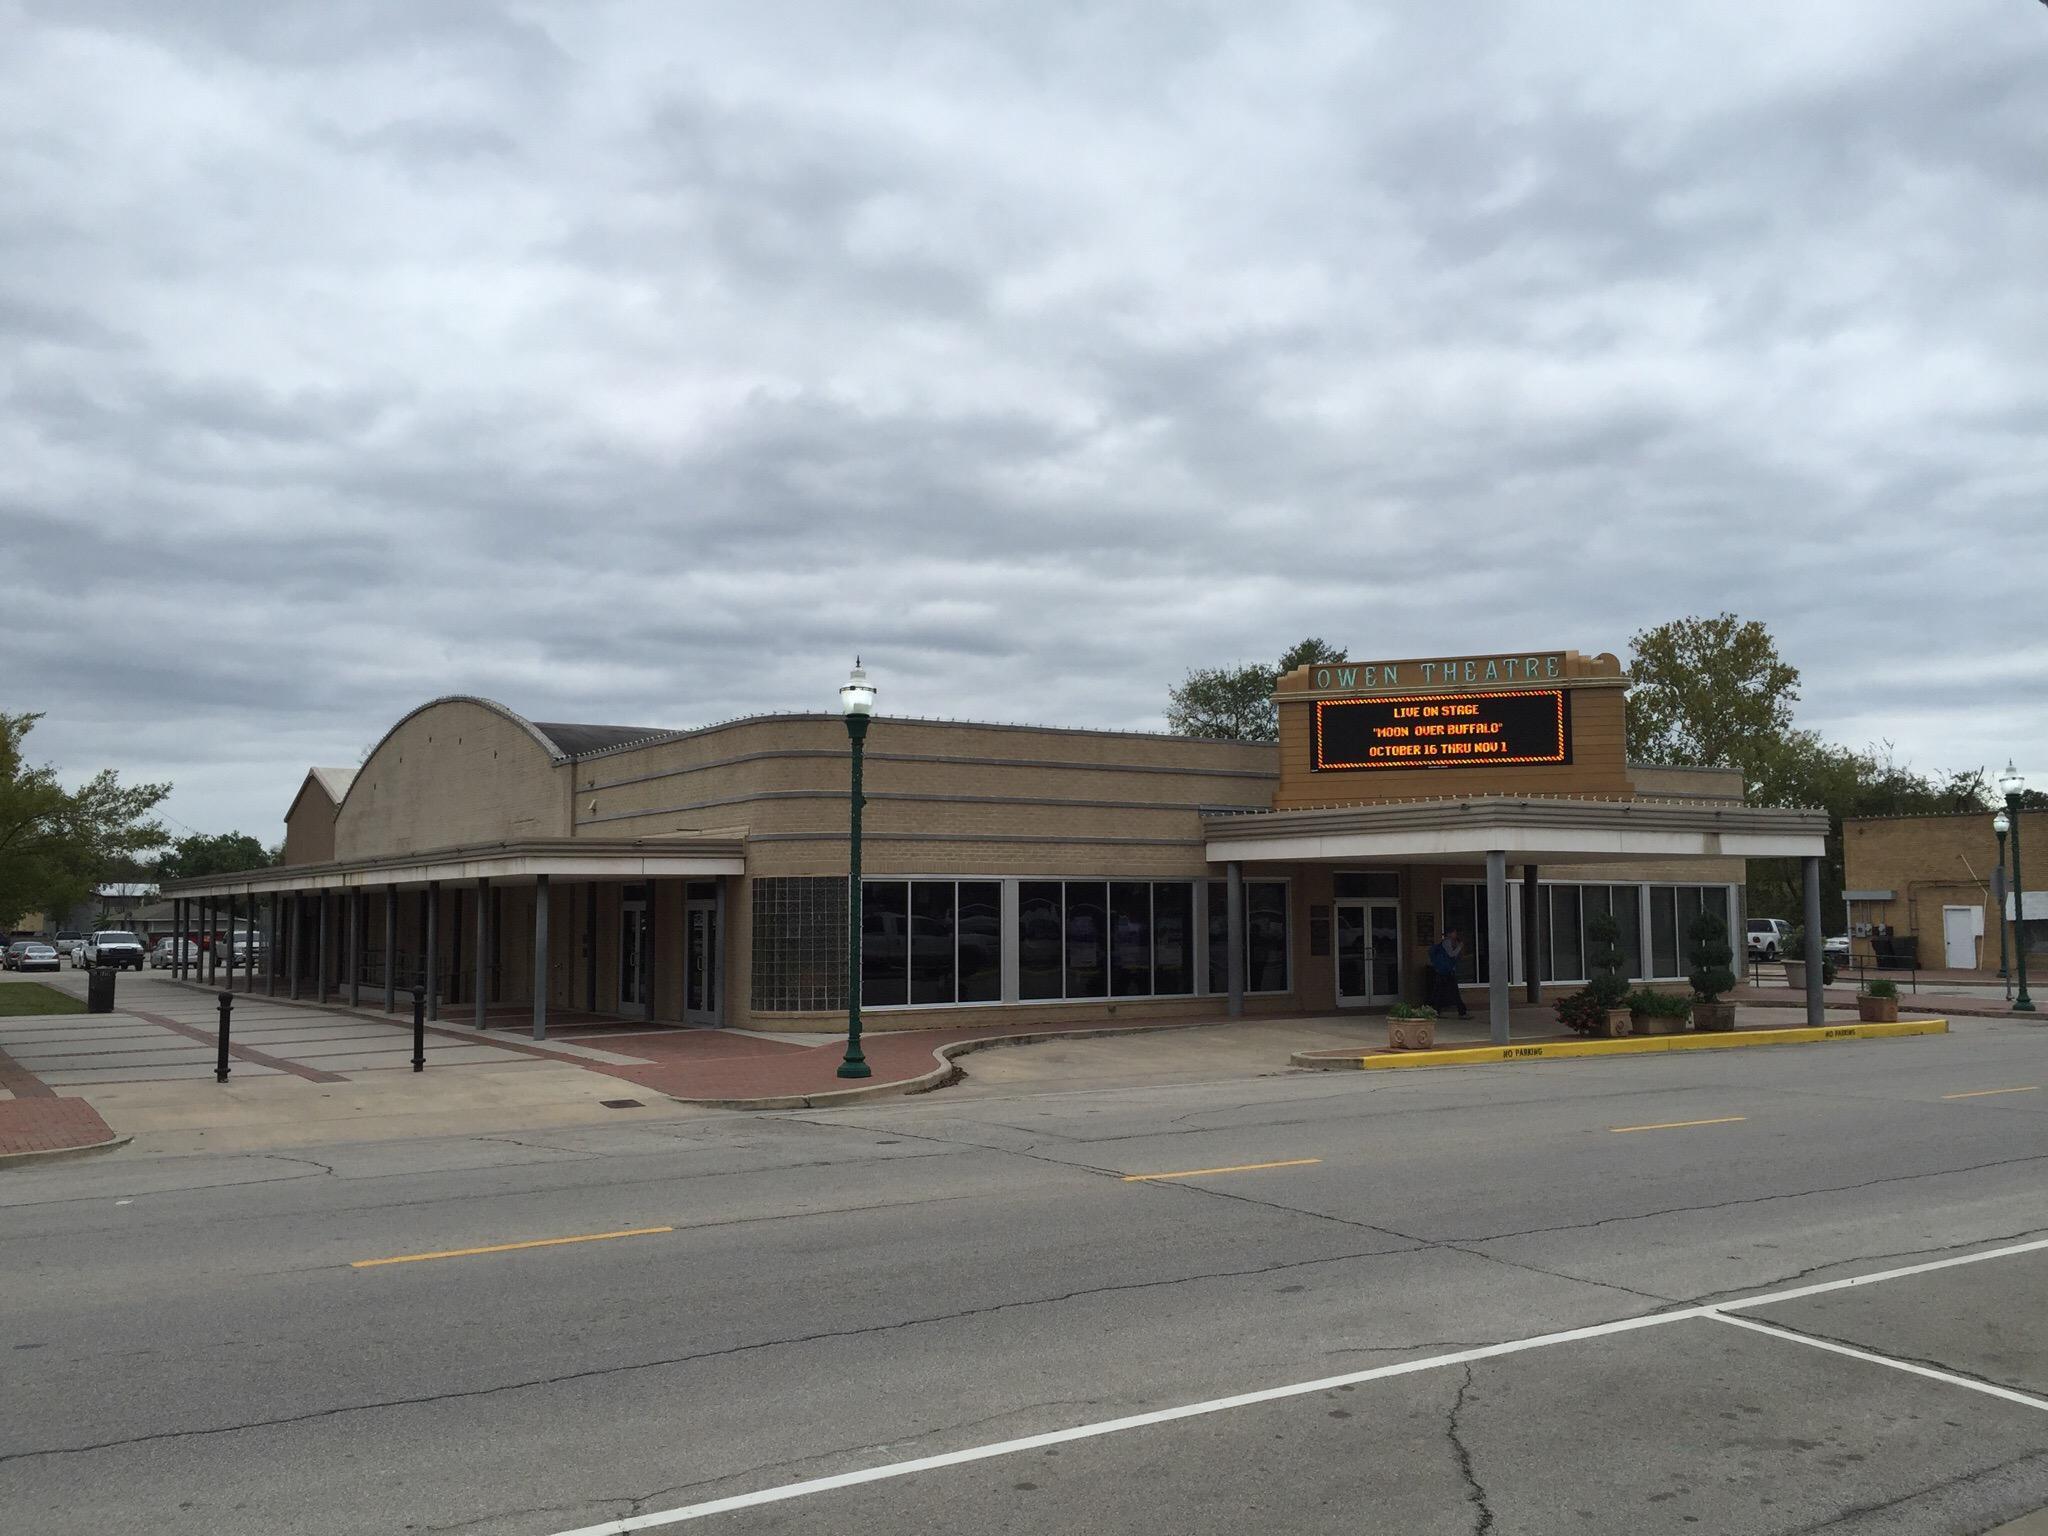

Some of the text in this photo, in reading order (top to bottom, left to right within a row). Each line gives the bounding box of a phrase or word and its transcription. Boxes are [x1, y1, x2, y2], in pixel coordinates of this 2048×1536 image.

[1316, 656, 1560, 689] OWEN THEATRE
[1393, 704, 1480, 719] LIVE ON STAGE
[1415, 724, 1445, 737] OVER
[1447, 722, 1503, 735] BUFFALO"
[1369, 741, 1507, 757] OCTOBER 16 THRU NOV 1
[1503, 1048, 1543, 1059] NO PARKING
